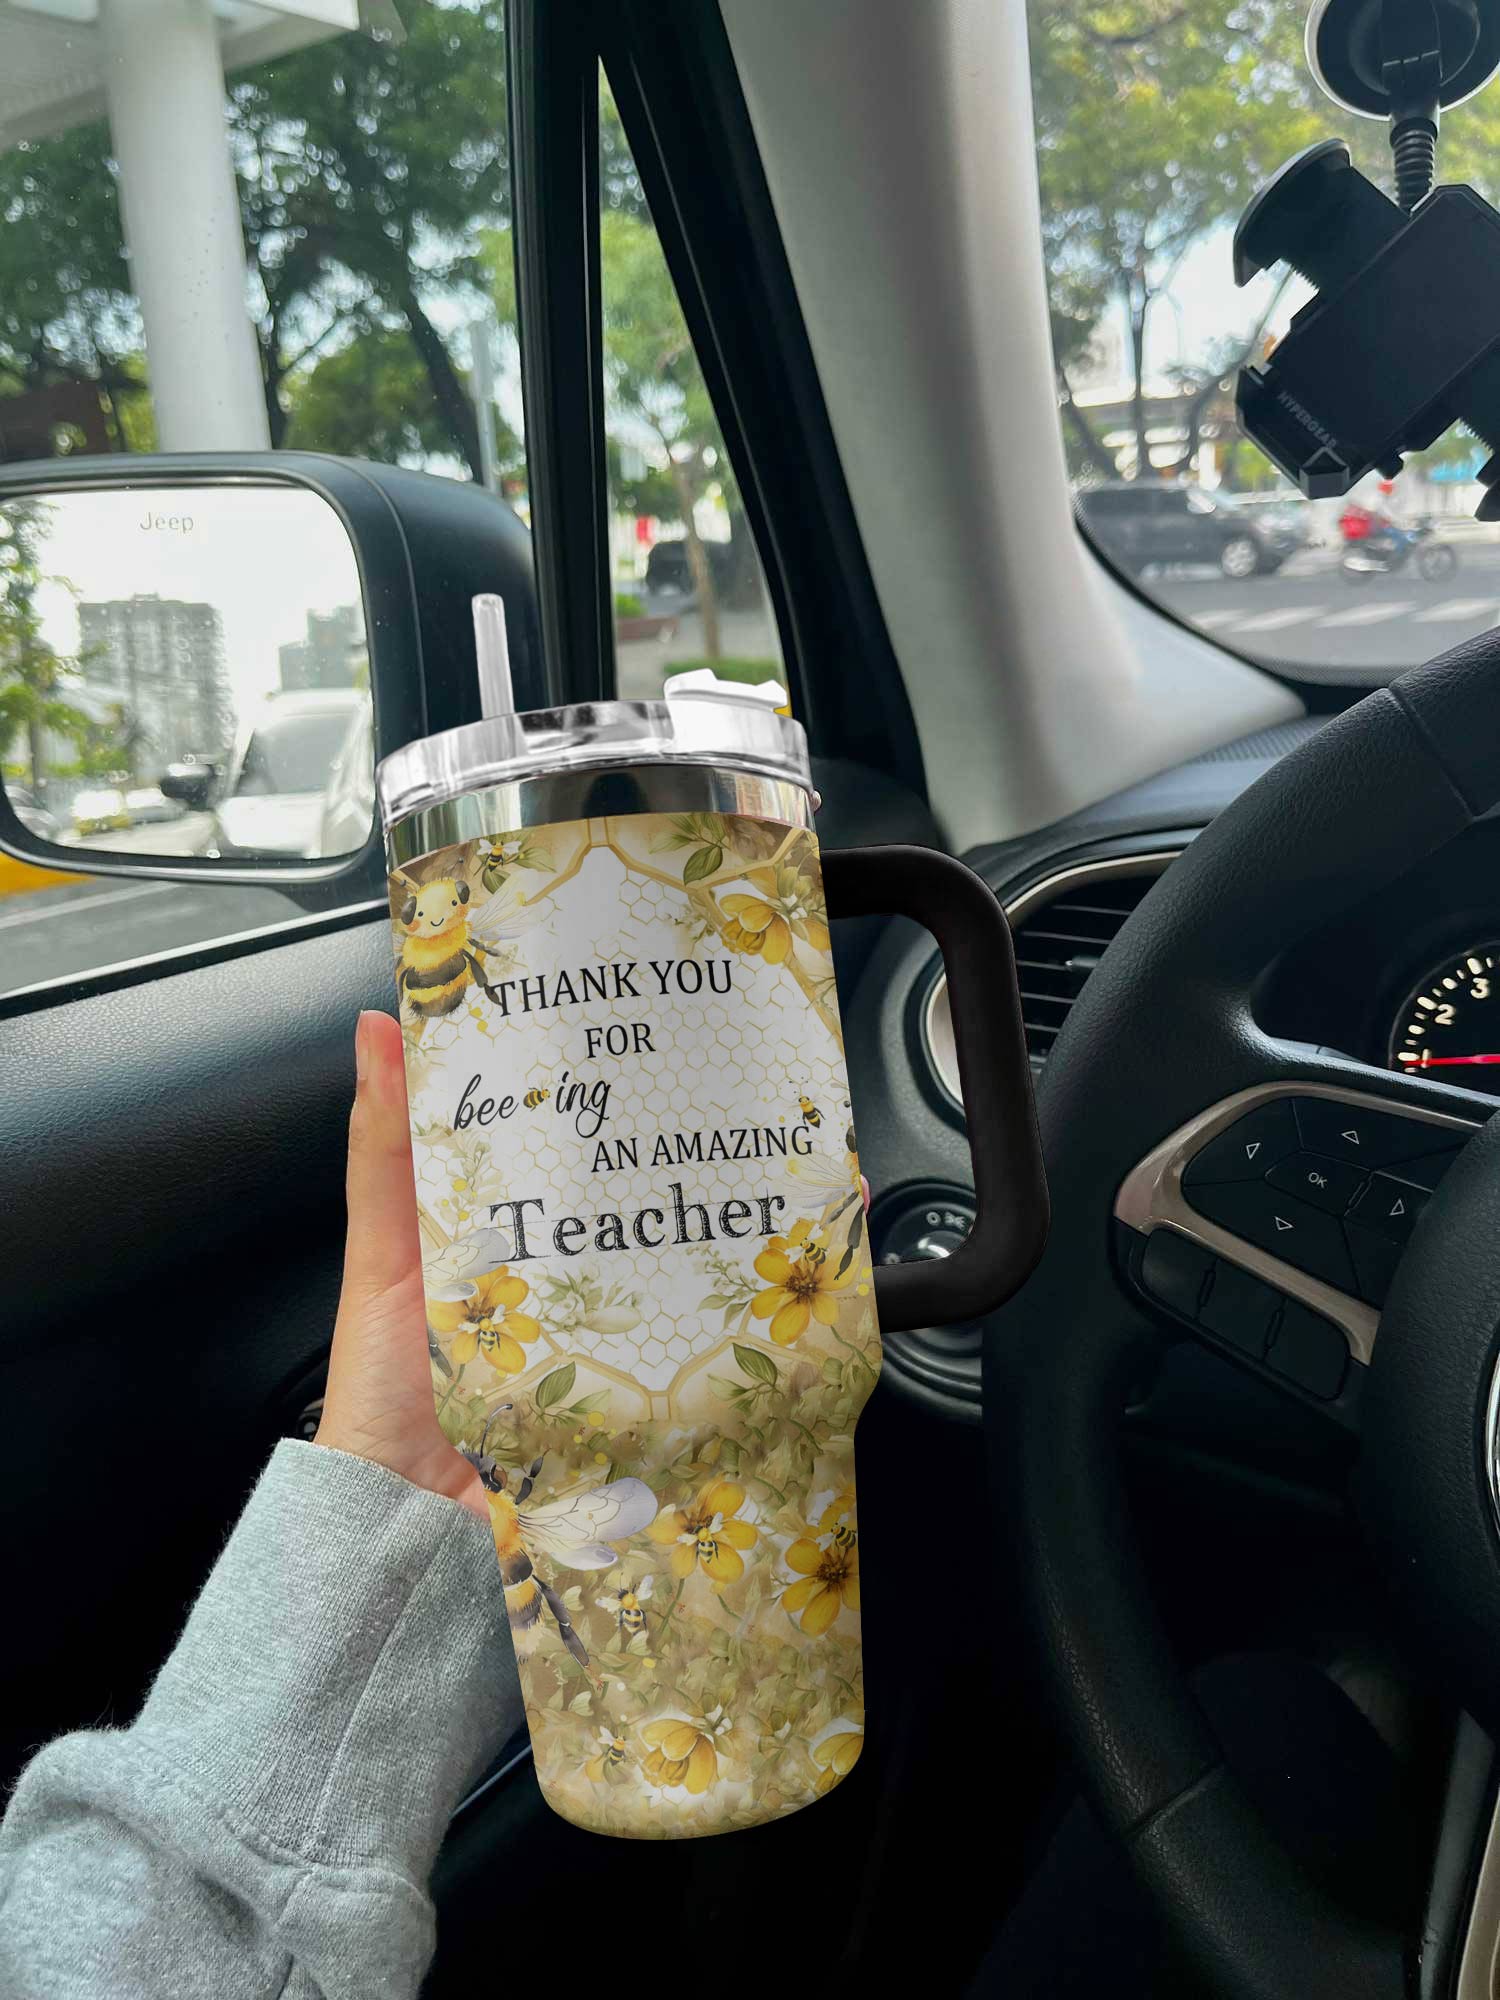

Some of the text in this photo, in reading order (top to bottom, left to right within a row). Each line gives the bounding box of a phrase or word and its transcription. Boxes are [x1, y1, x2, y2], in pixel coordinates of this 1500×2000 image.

[1277, 391, 1337, 449] HYPERGEAR
[140, 511, 194, 534] Jeep
[491, 959, 733, 1017] THANK YOU
[1470, 977, 1489, 999] 3
[1435, 1003, 1455, 1025] 2
[584, 1023, 656, 1058] FOR
[453, 1071, 612, 1139] bee ing
[590, 1126, 813, 1173] AN AMAZING
[1308, 1172, 1328, 1189] OK
[489, 1183, 786, 1264] Teacher
